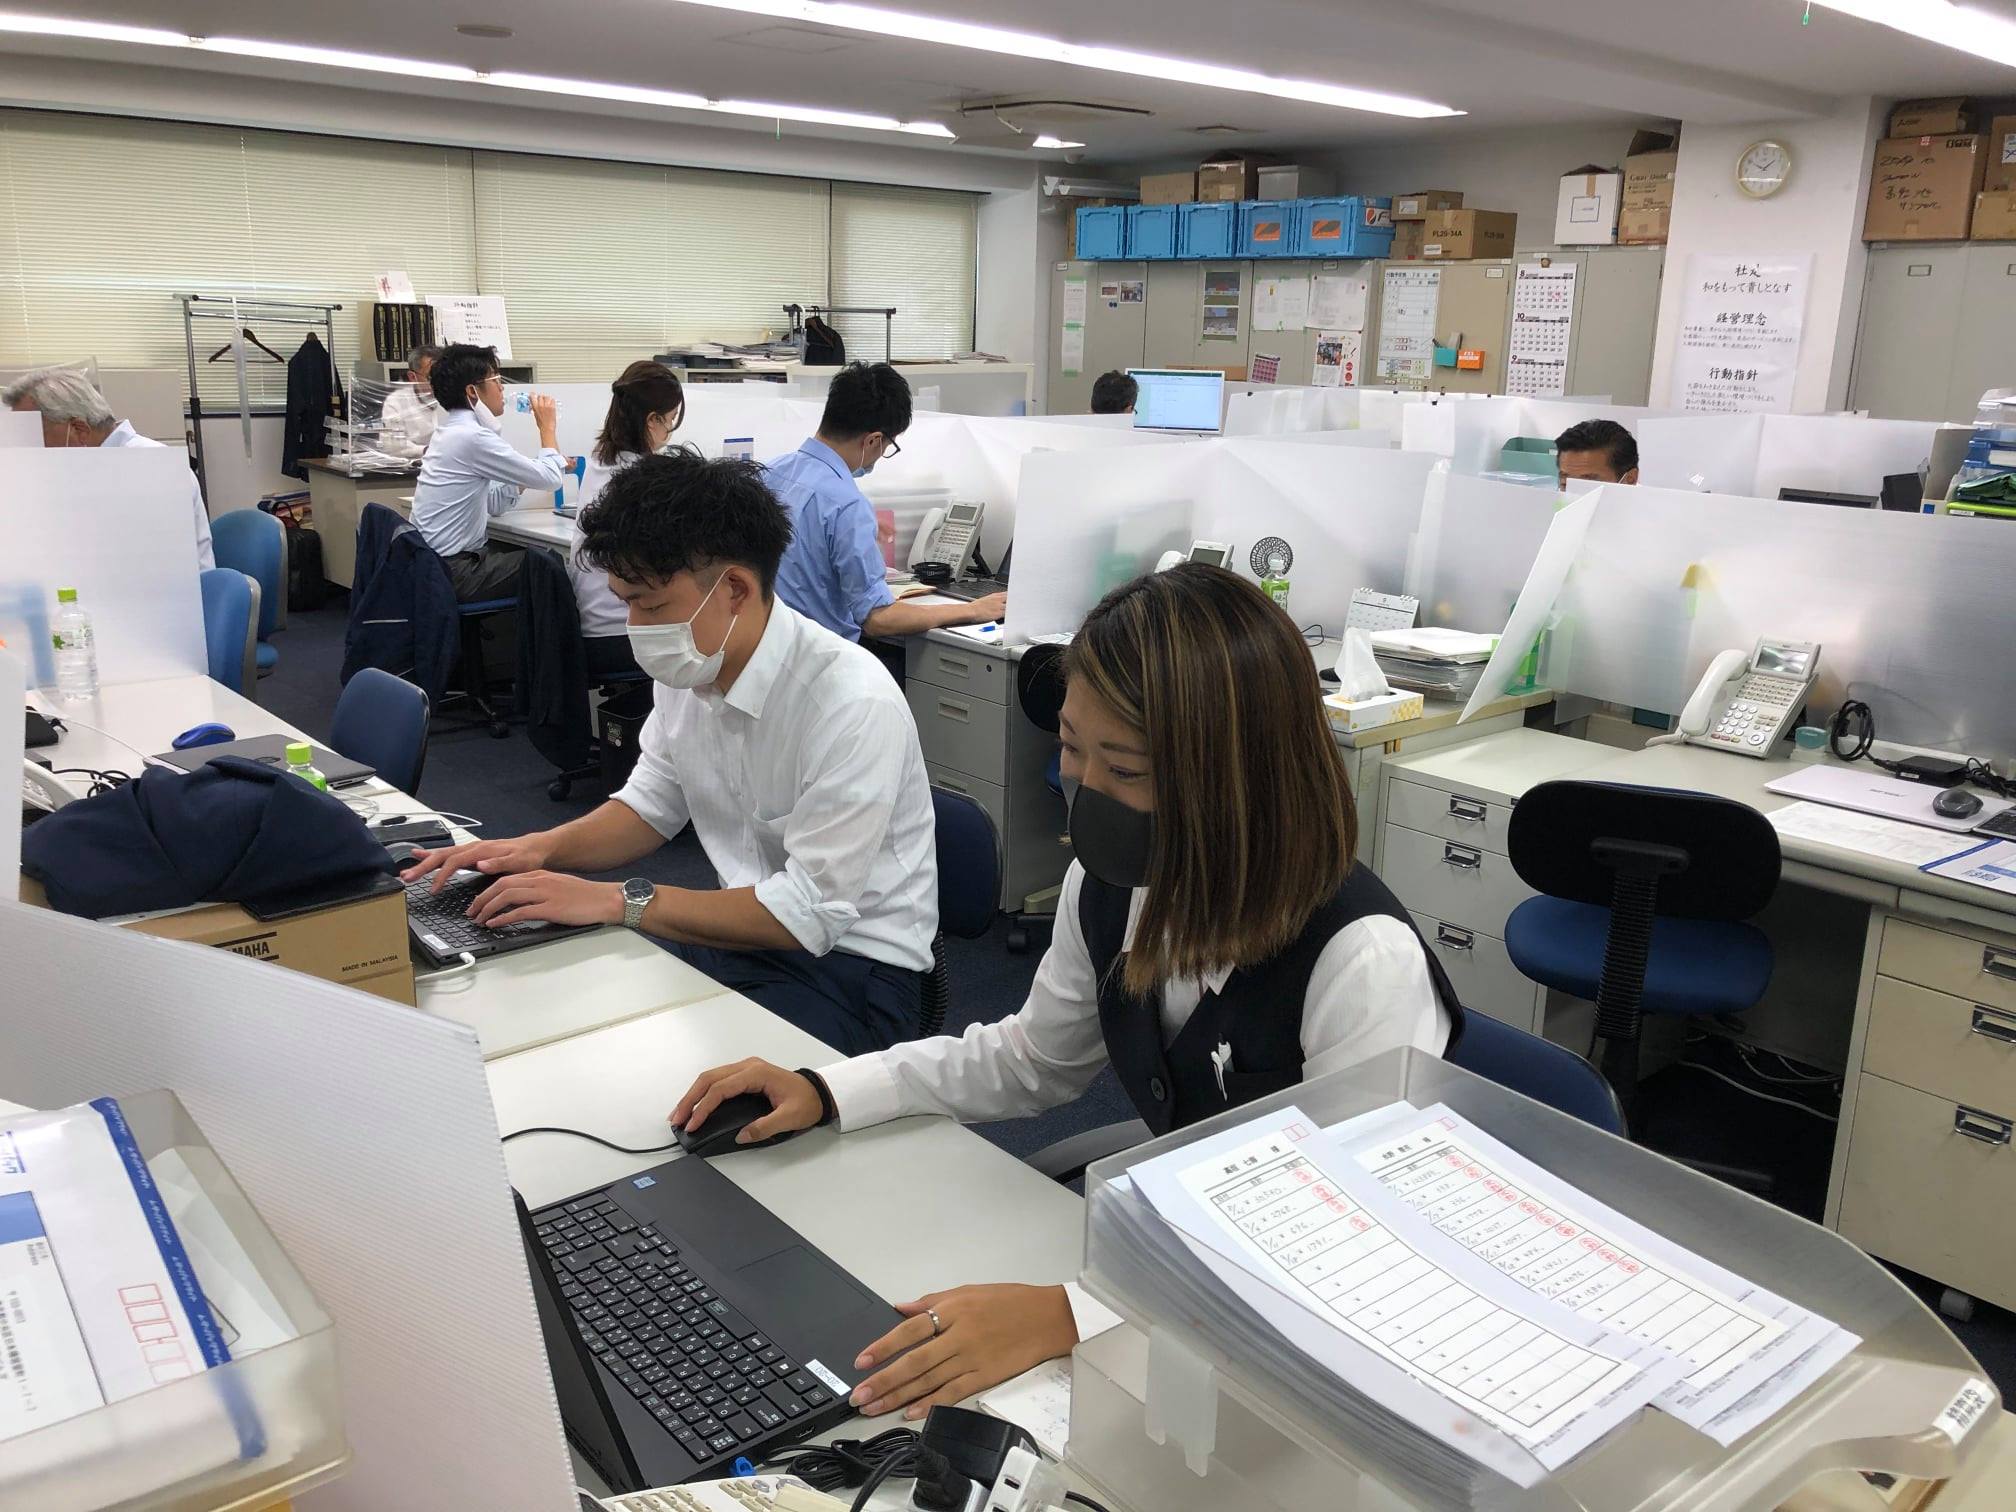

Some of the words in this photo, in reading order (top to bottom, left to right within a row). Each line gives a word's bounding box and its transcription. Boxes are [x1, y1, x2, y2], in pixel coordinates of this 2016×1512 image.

[1517, 312, 1526, 320] 10
[1715, 311, 1768, 326] 経営理念
[1708, 367, 1759, 382] 行動指針
[226, 941, 270, 957] MAHA
[341, 963, 359, 973] MADE
[361, 961, 369, 969] IN
[369, 954, 399, 967] MALAYSIA
